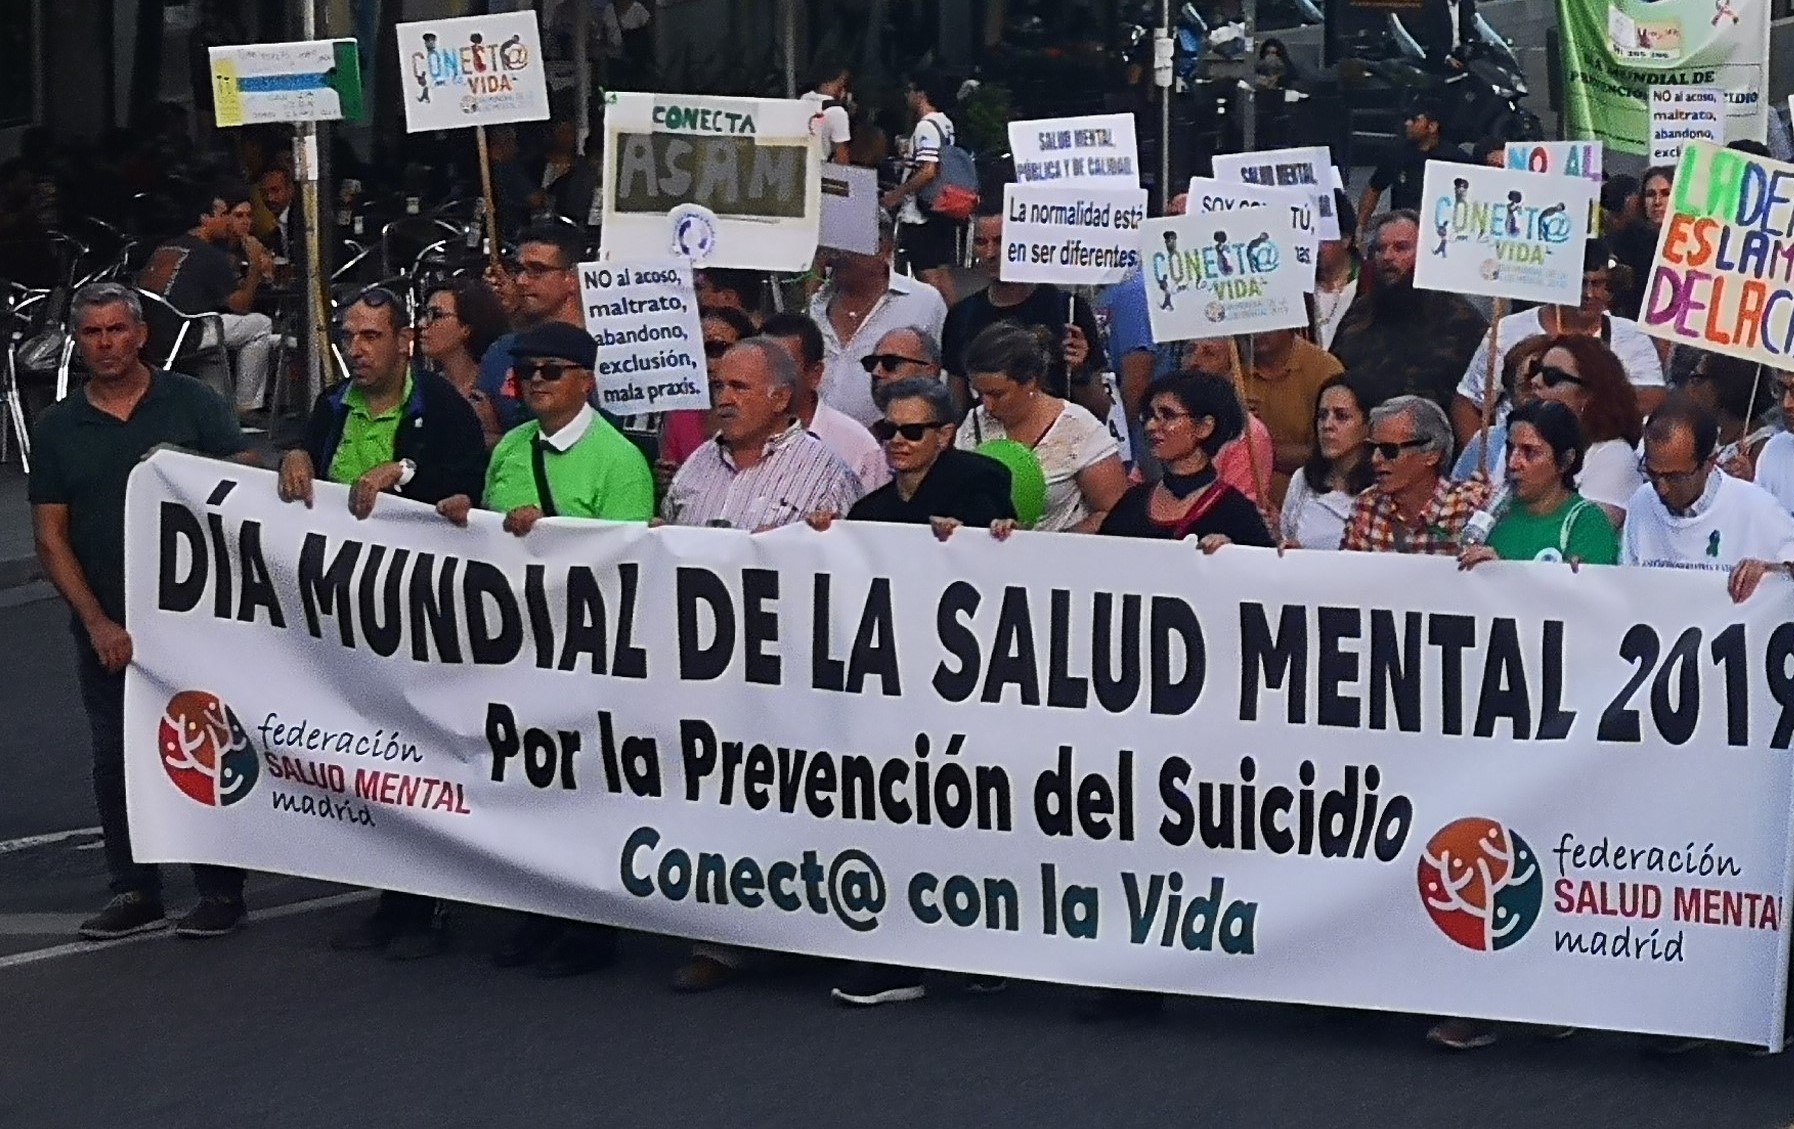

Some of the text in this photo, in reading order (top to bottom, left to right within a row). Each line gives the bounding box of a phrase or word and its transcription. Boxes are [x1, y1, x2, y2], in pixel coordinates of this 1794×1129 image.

[467, 74, 513, 95] VIDA
[1653, 90, 1671, 102] NO
[652, 105, 757, 134] CONECTA
[1507, 144, 1603, 182] NO AL
[1009, 196, 1027, 223] La
[1030, 199, 1112, 229] normalidad
[1007, 241, 1027, 263] en
[1031, 241, 1057, 264] ser
[1495, 240, 1546, 266] VIDA
[583, 267, 682, 290] NO al acoso,
[1213, 277, 1263, 301] VIDA
[588, 296, 688, 319] maltrato,
[593, 323, 688, 347] abandono,
[599, 348, 697, 375] exclusión,
[603, 376, 702, 405] mala praxis.
[158, 479, 287, 629] DÍA
[298, 532, 648, 680] MUNDIAL
[676, 565, 782, 686] DE
[811, 572, 903, 697] LA
[931, 579, 1207, 717] SALUD
[1239, 599, 1578, 741] MENTAL
[257, 712, 424, 764] federación
[264, 751, 472, 815] SALUD MENTAL
[485, 702, 1416, 863] Por la Prevención del Suicidio
[272, 790, 376, 828] madrid
[1552, 832, 1742, 878] federación
[619, 825, 1260, 957] Conect@ con la Vida
[1553, 877, 1663, 920] SALUD
[1554, 925, 1685, 963] madrid
